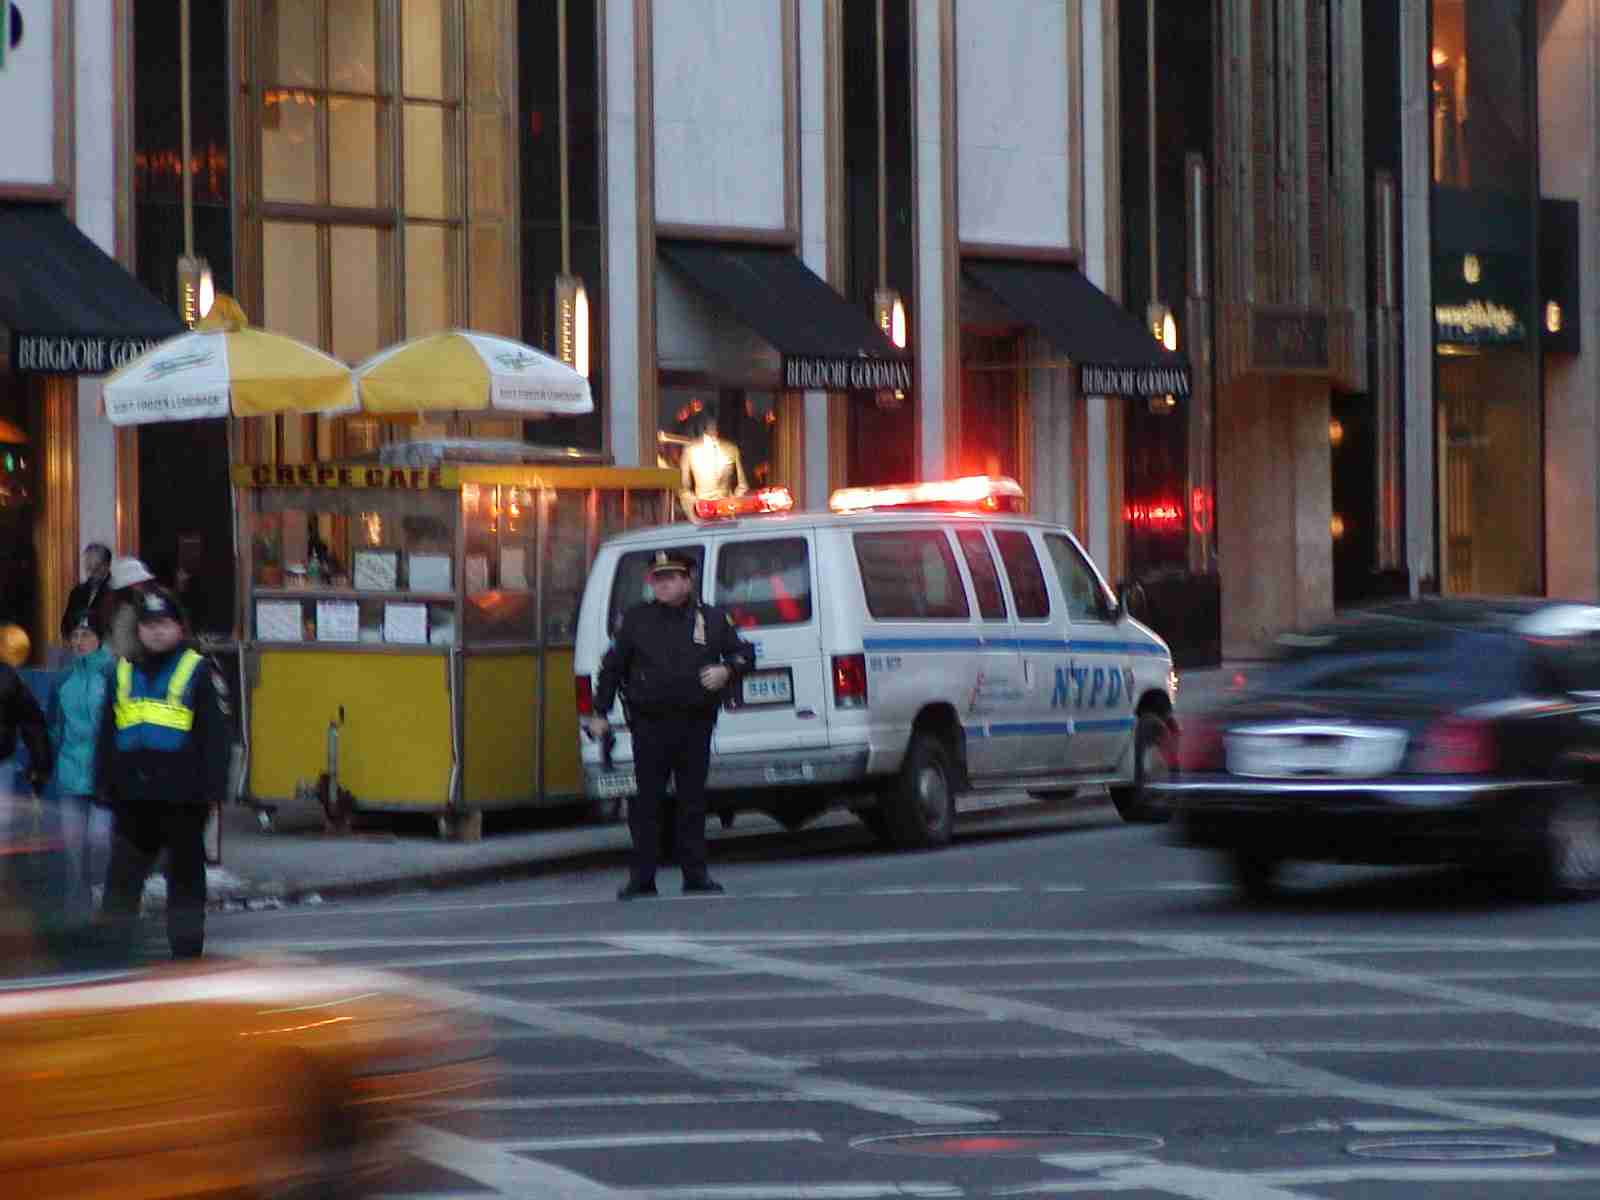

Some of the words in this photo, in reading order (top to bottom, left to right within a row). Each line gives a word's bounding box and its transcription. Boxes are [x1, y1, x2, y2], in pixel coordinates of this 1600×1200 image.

[18, 336, 106, 370] BERGDORF
[786, 359, 847, 386] BERGDORF
[850, 360, 912, 389] GOODMAN
[1081, 366, 1134, 393] BERGDORF
[1136, 367, 1190, 395] GOODMAN
[1051, 666, 1122, 709] NYPD
